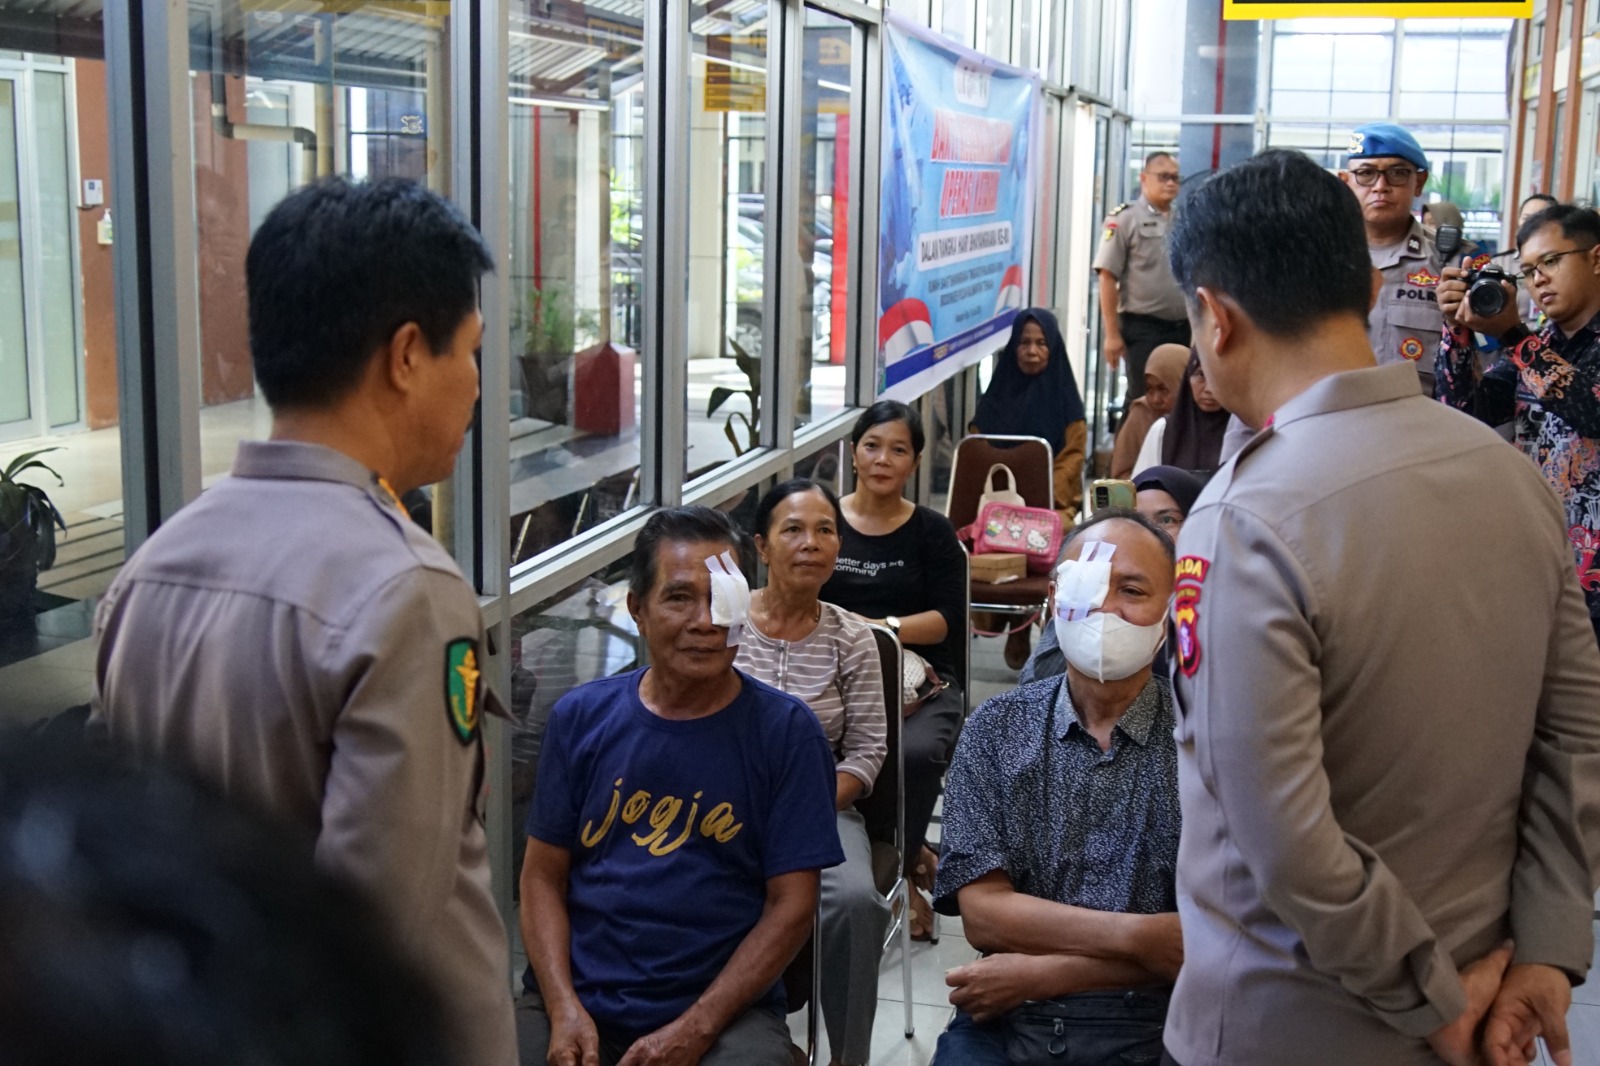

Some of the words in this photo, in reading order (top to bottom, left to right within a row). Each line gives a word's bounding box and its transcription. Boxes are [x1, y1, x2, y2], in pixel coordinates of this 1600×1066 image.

[921, 239, 938, 263] DALAM
[1396, 288, 1437, 302] POLR
[833, 564, 878, 577] omming
[863, 560, 887, 570] days
[580, 777, 743, 857] jogja
